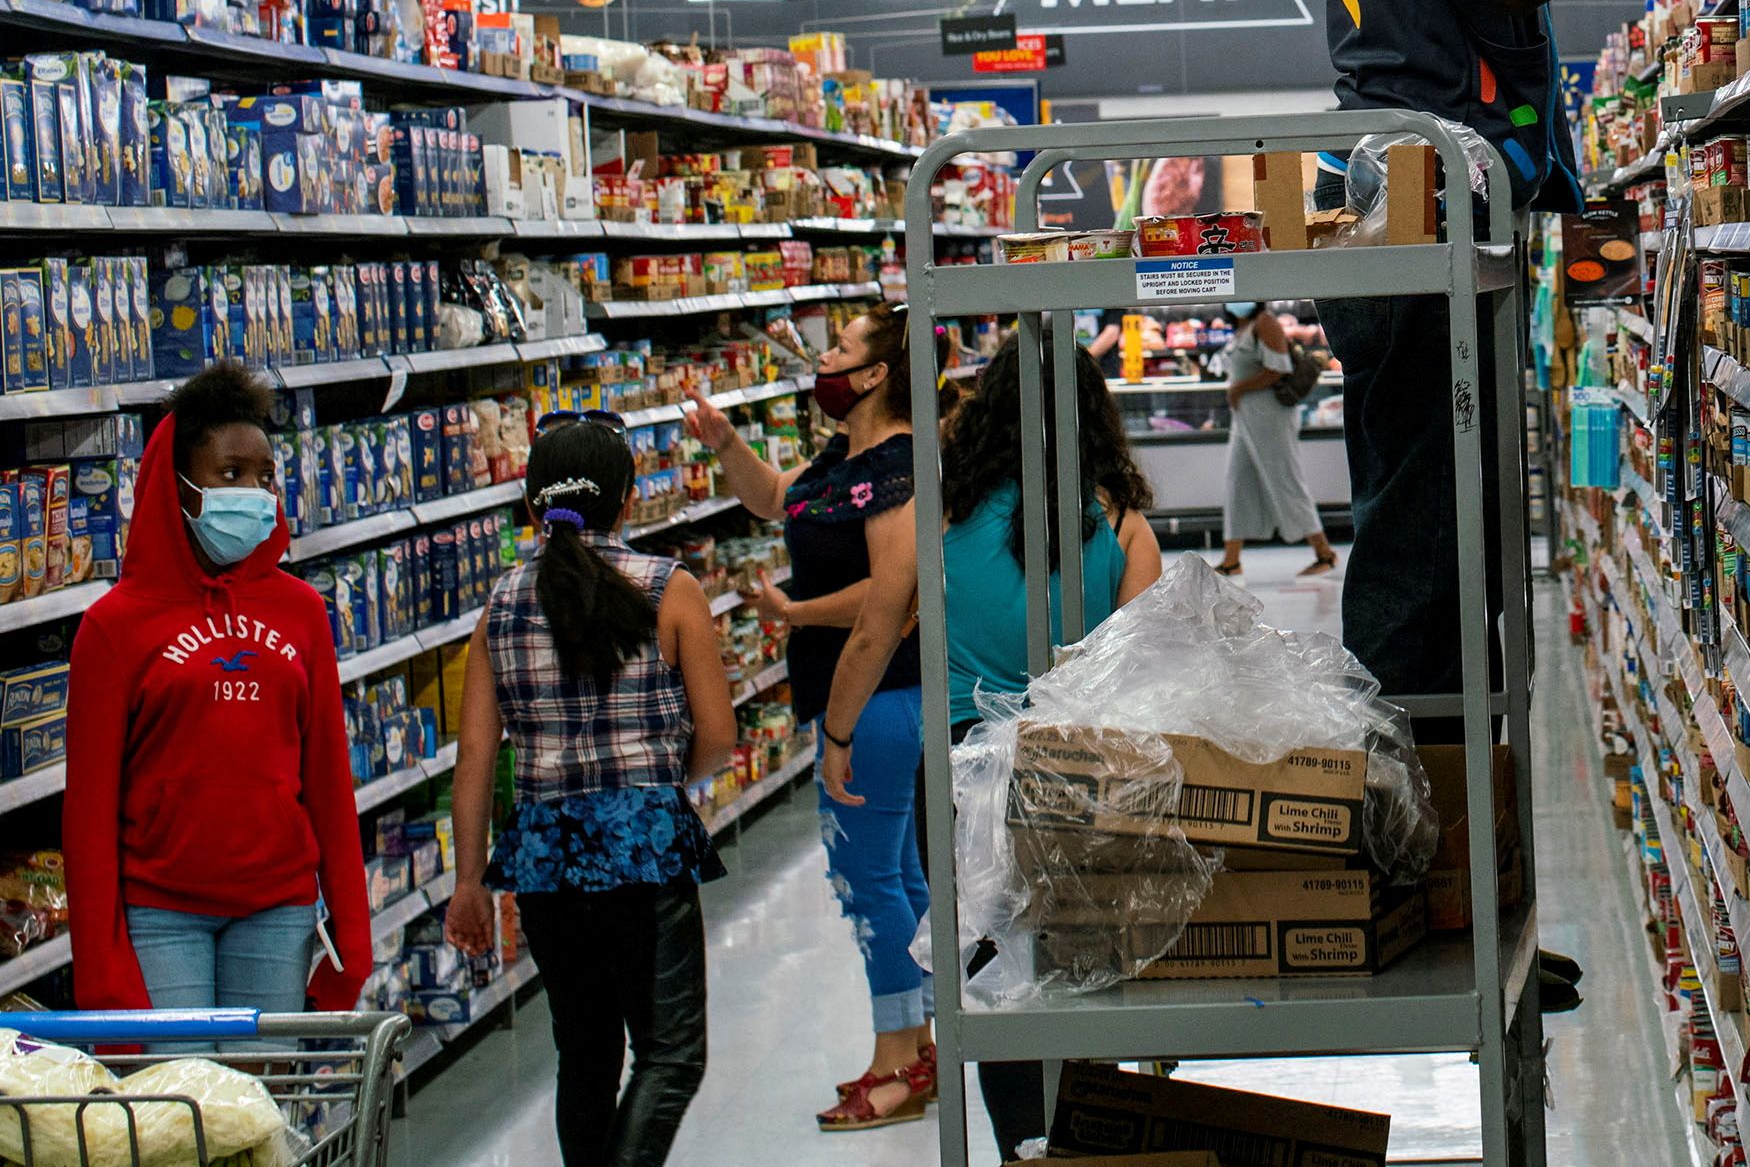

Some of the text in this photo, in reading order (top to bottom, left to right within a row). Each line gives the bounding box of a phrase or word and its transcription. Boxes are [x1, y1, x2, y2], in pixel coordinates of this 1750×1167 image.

[1171, 261, 1198, 270] NOTICE
[162, 613, 297, 664] HOLLISTER
[214, 680, 260, 701] 1922
[1288, 755, 1351, 771] 41789-90115
[1279, 804, 1338, 820] Lime Chili
[1274, 820, 1341, 838] With Shrimp
[1303, 879, 1364, 890] 41789-90115
[1296, 932, 1352, 944] Lime Chili
[1292, 948, 1358, 962] With Shrimp
